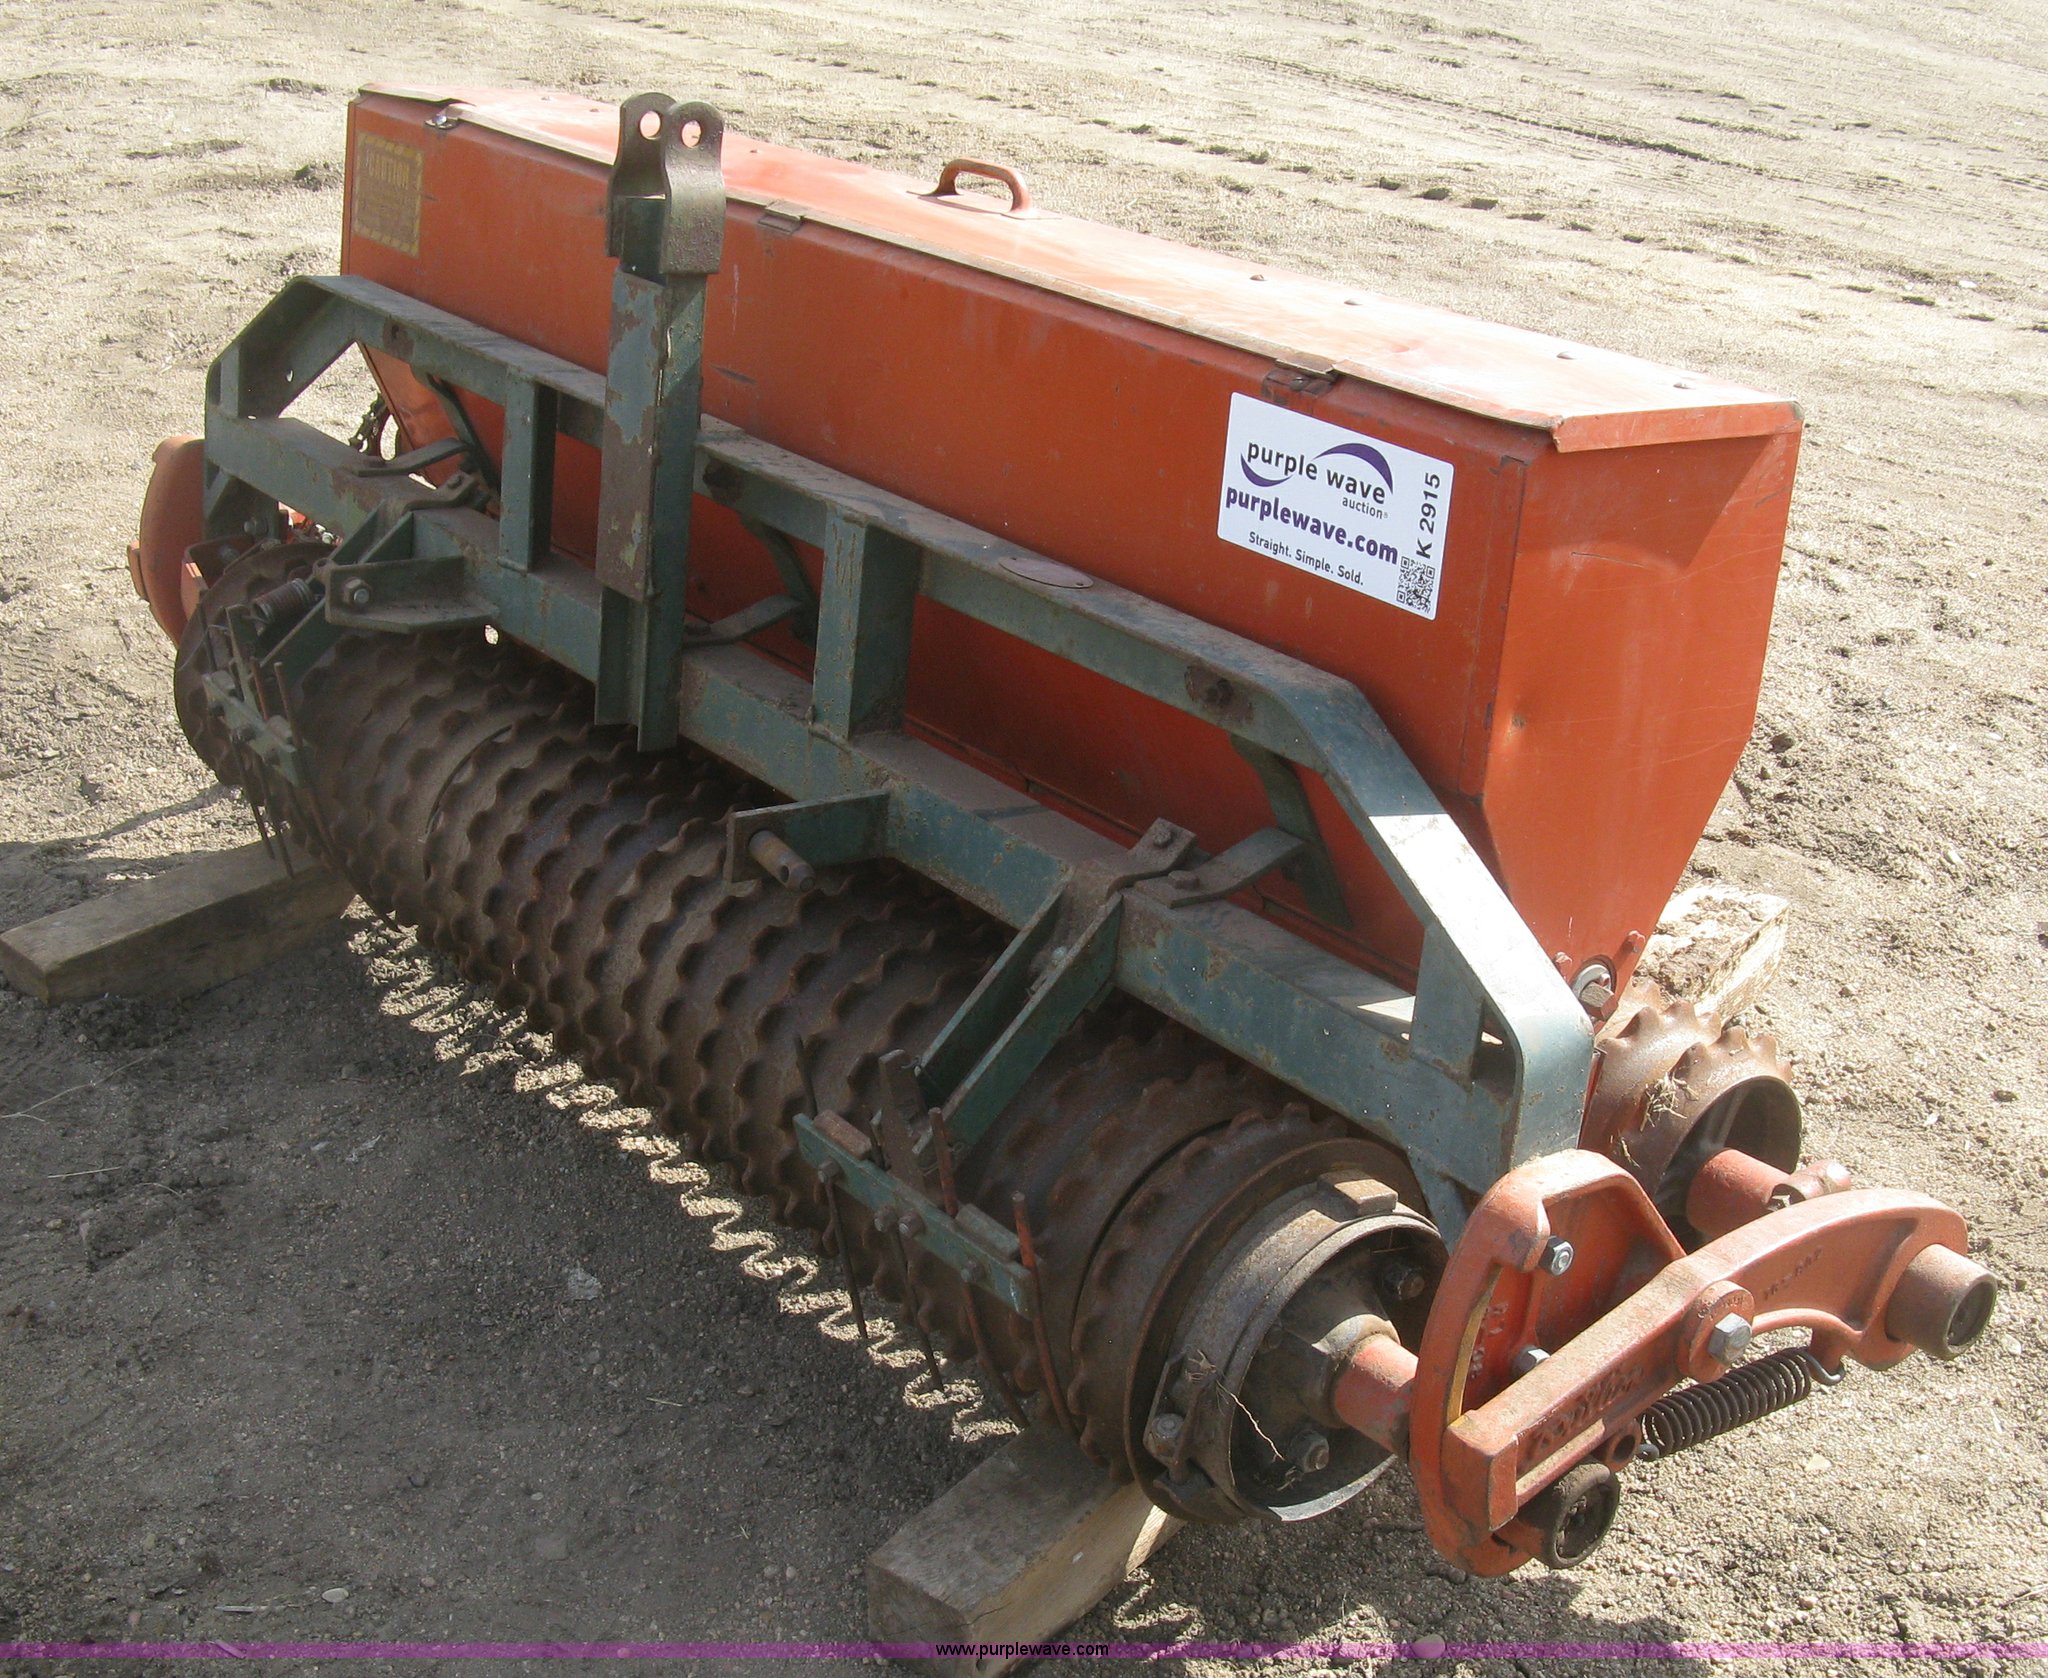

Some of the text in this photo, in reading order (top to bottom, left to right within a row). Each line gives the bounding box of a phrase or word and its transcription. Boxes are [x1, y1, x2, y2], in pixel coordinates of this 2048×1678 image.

[1247, 441, 1386, 505] purple wave
[1225, 485, 1399, 565] purplewave.com
[1341, 496, 1383, 520] auction
[1415, 472, 1441, 560] K 2915
[1248, 531, 1364, 586] Straight. Simple. Sold.
